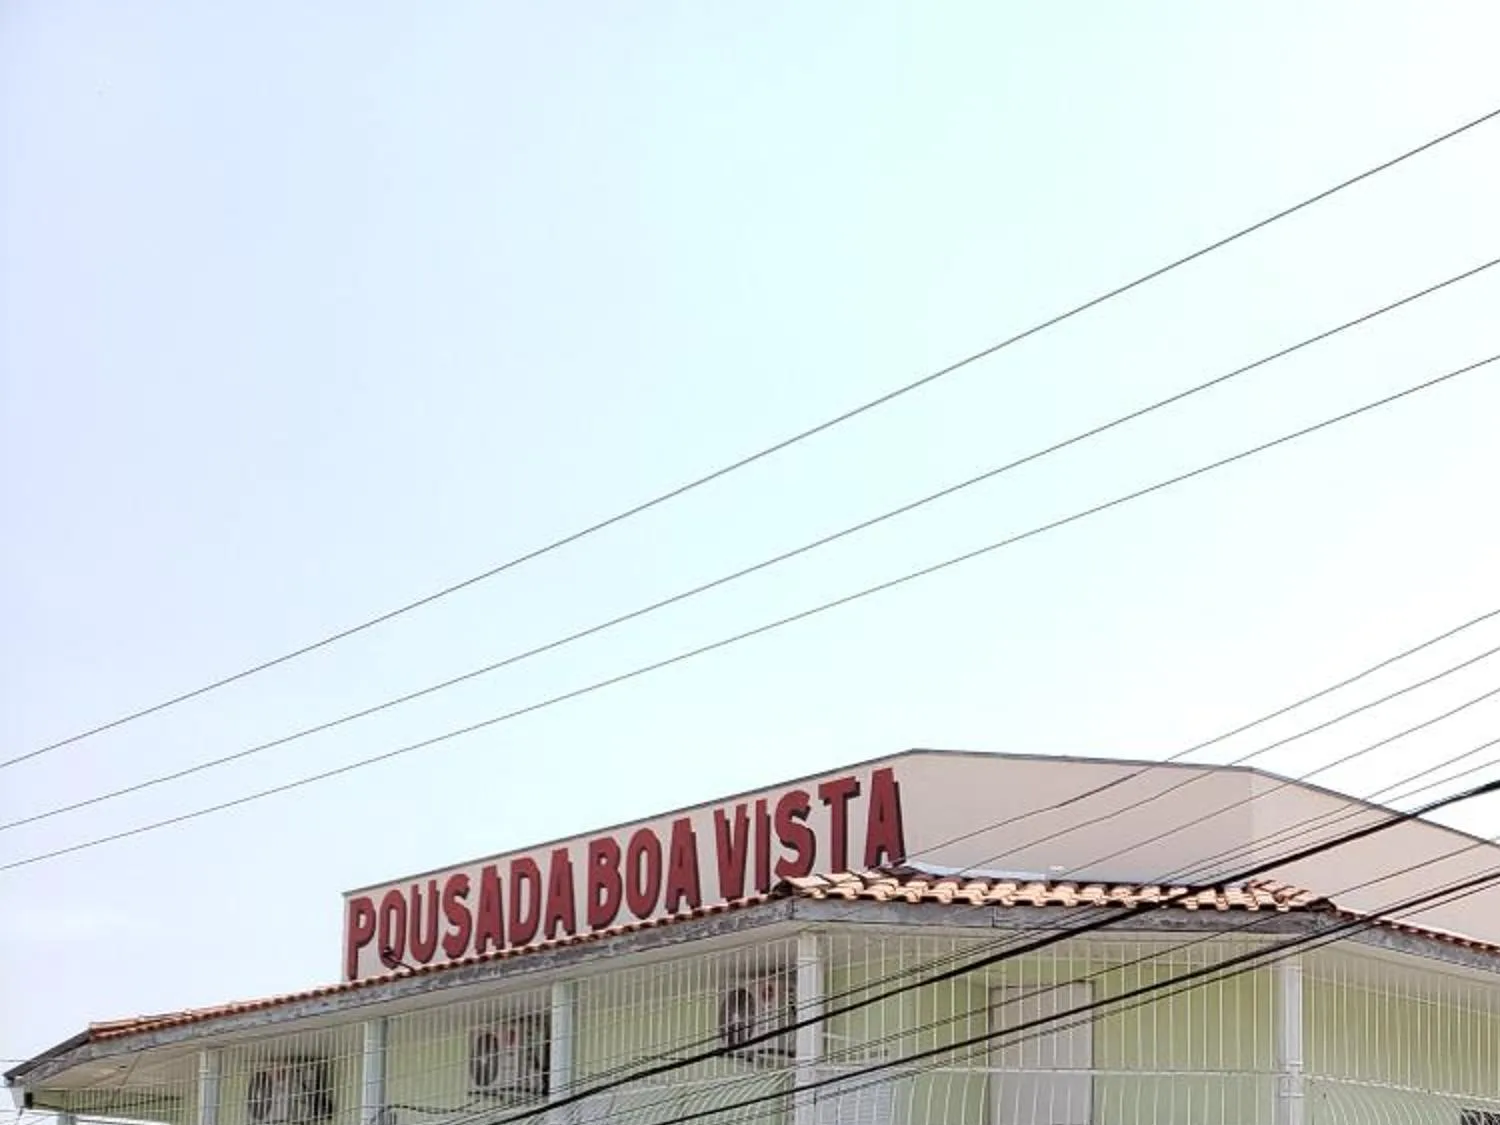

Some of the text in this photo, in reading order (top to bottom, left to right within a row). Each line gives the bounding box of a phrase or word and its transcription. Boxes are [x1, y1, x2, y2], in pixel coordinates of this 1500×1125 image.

[348, 767, 906, 980] POUSADA BOA VISTA
